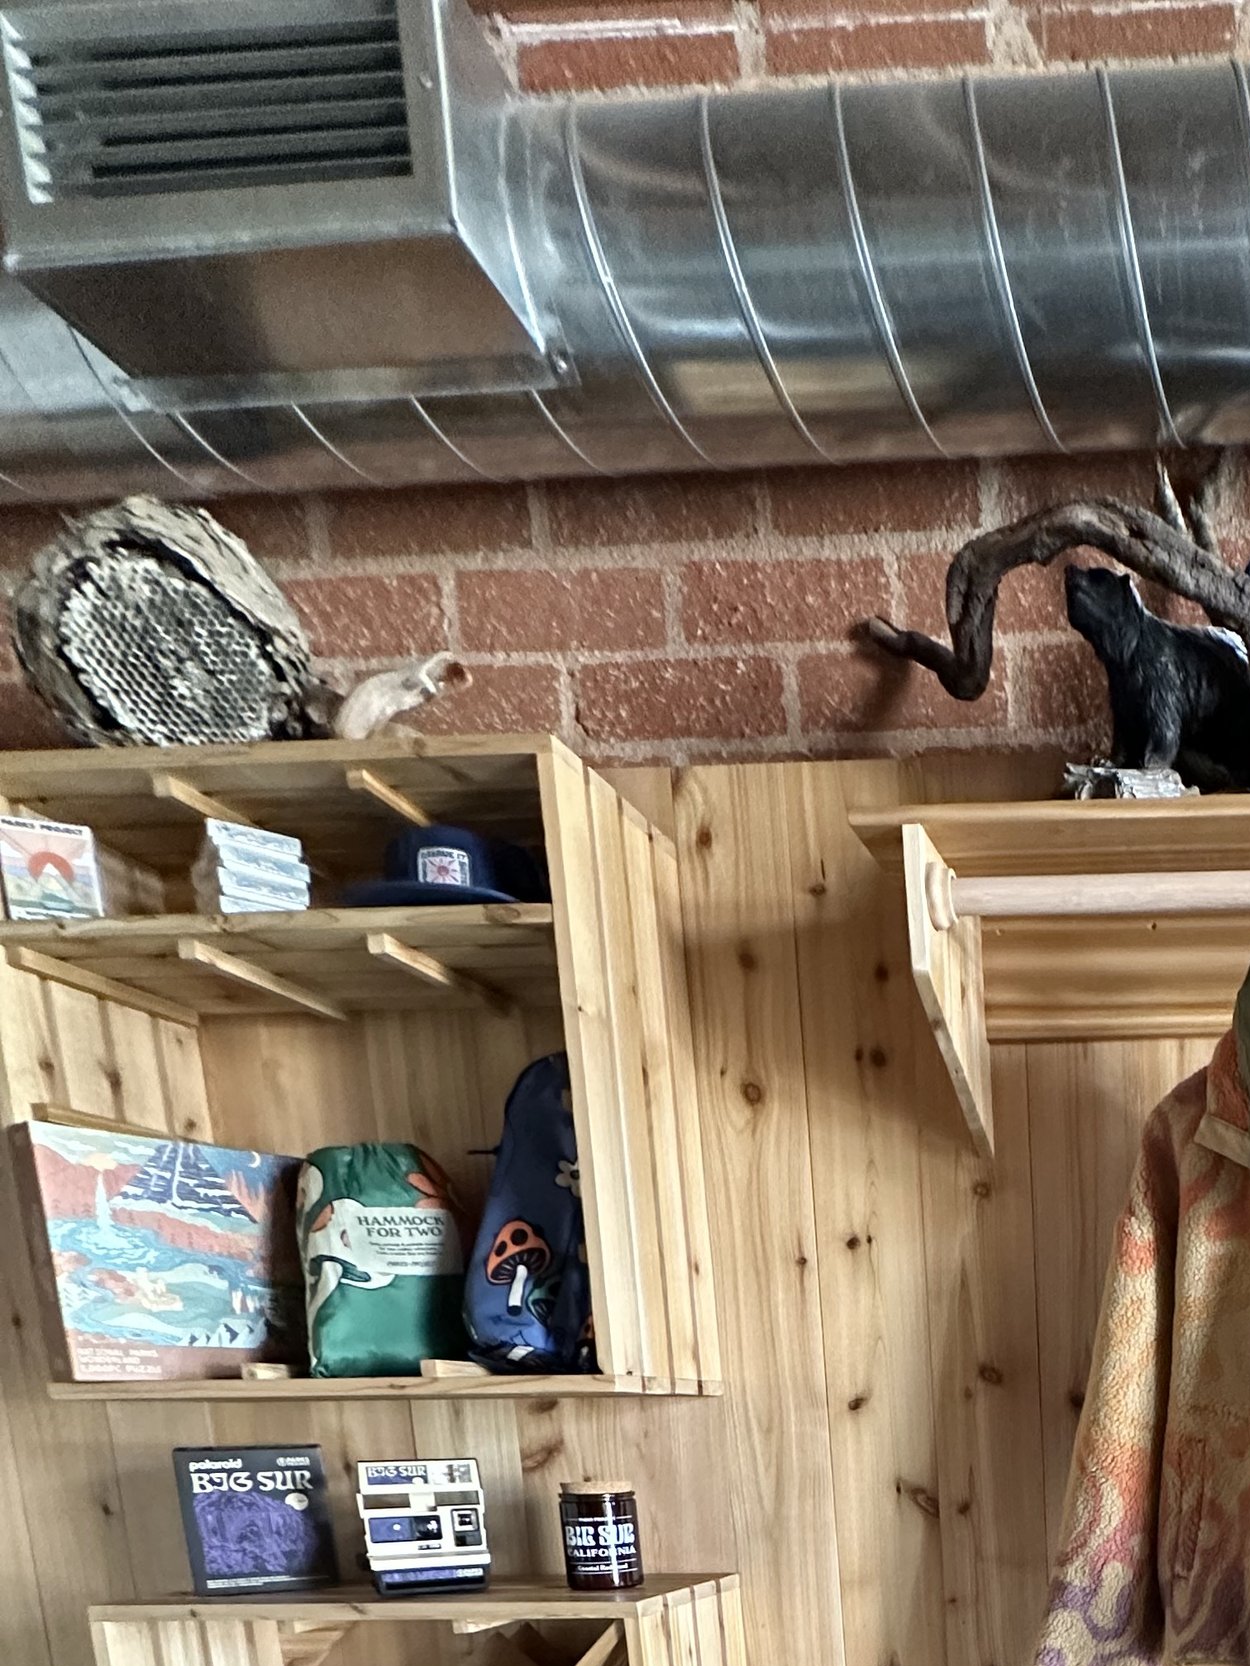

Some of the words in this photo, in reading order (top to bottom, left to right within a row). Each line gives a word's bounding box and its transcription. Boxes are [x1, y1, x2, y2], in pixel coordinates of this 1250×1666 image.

[357, 1215, 446, 1227] HAMMOCK
[366, 1227, 402, 1238] FOR
[404, 1226, 443, 1237] TWO
[189, 1458, 243, 1473] polaroid
[367, 1466, 398, 1478] BIG
[398, 1465, 427, 1477] SUR
[190, 1472, 254, 1494] BIG
[256, 1469, 314, 1492] SUR
[564, 1526, 596, 1547] BIG
[597, 1523, 636, 1546] SUR
[567, 1545, 637, 1558] CALIFONIA
